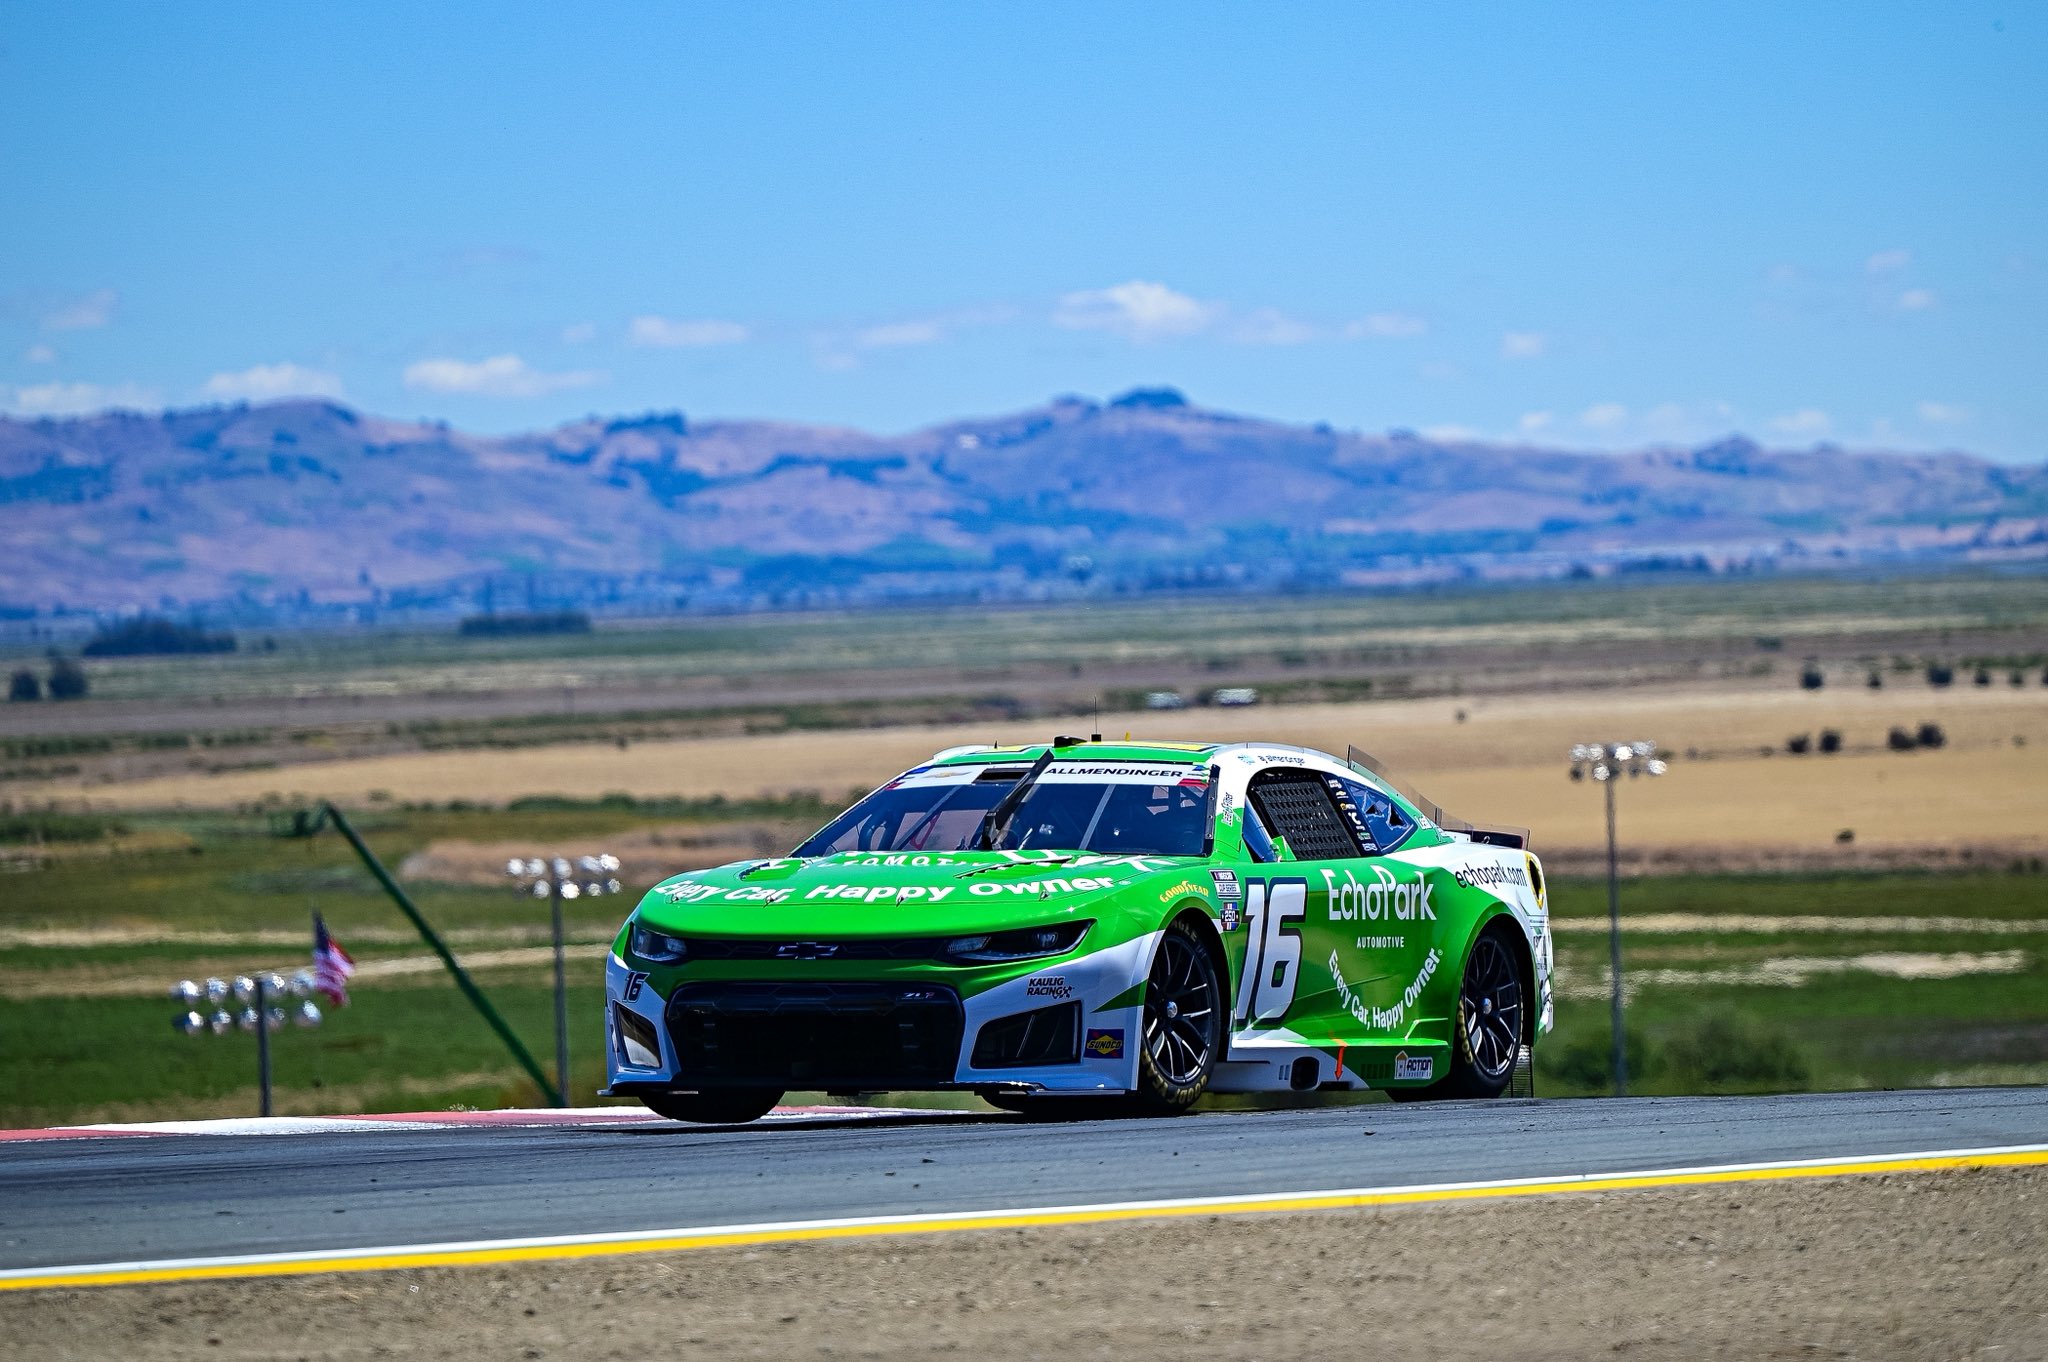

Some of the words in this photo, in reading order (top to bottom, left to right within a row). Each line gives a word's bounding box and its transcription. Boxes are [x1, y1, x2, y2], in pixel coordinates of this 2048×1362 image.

[1044, 767, 1183, 778] ALLMENDINGER
[1455, 859, 1528, 889] echopark.com
[804, 885, 955, 902] Happy
[1159, 880, 1209, 903] GOODYEAR
[1320, 865, 1438, 921] EchoPark
[1224, 910, 1236, 922] 250
[1356, 936, 1405, 949] AUTOMOTIVE
[1234, 877, 1308, 1027] 16
[622, 968, 651, 1003] 16
[1028, 976, 1065, 987] KAULIG
[1026, 986, 1064, 998] RACING
[1328, 949, 1351, 1008] Every
[1351, 995, 1370, 1031] Car,
[1372, 999, 1403, 1032] Happy
[1089, 1040, 1123, 1050] SUNOCO
